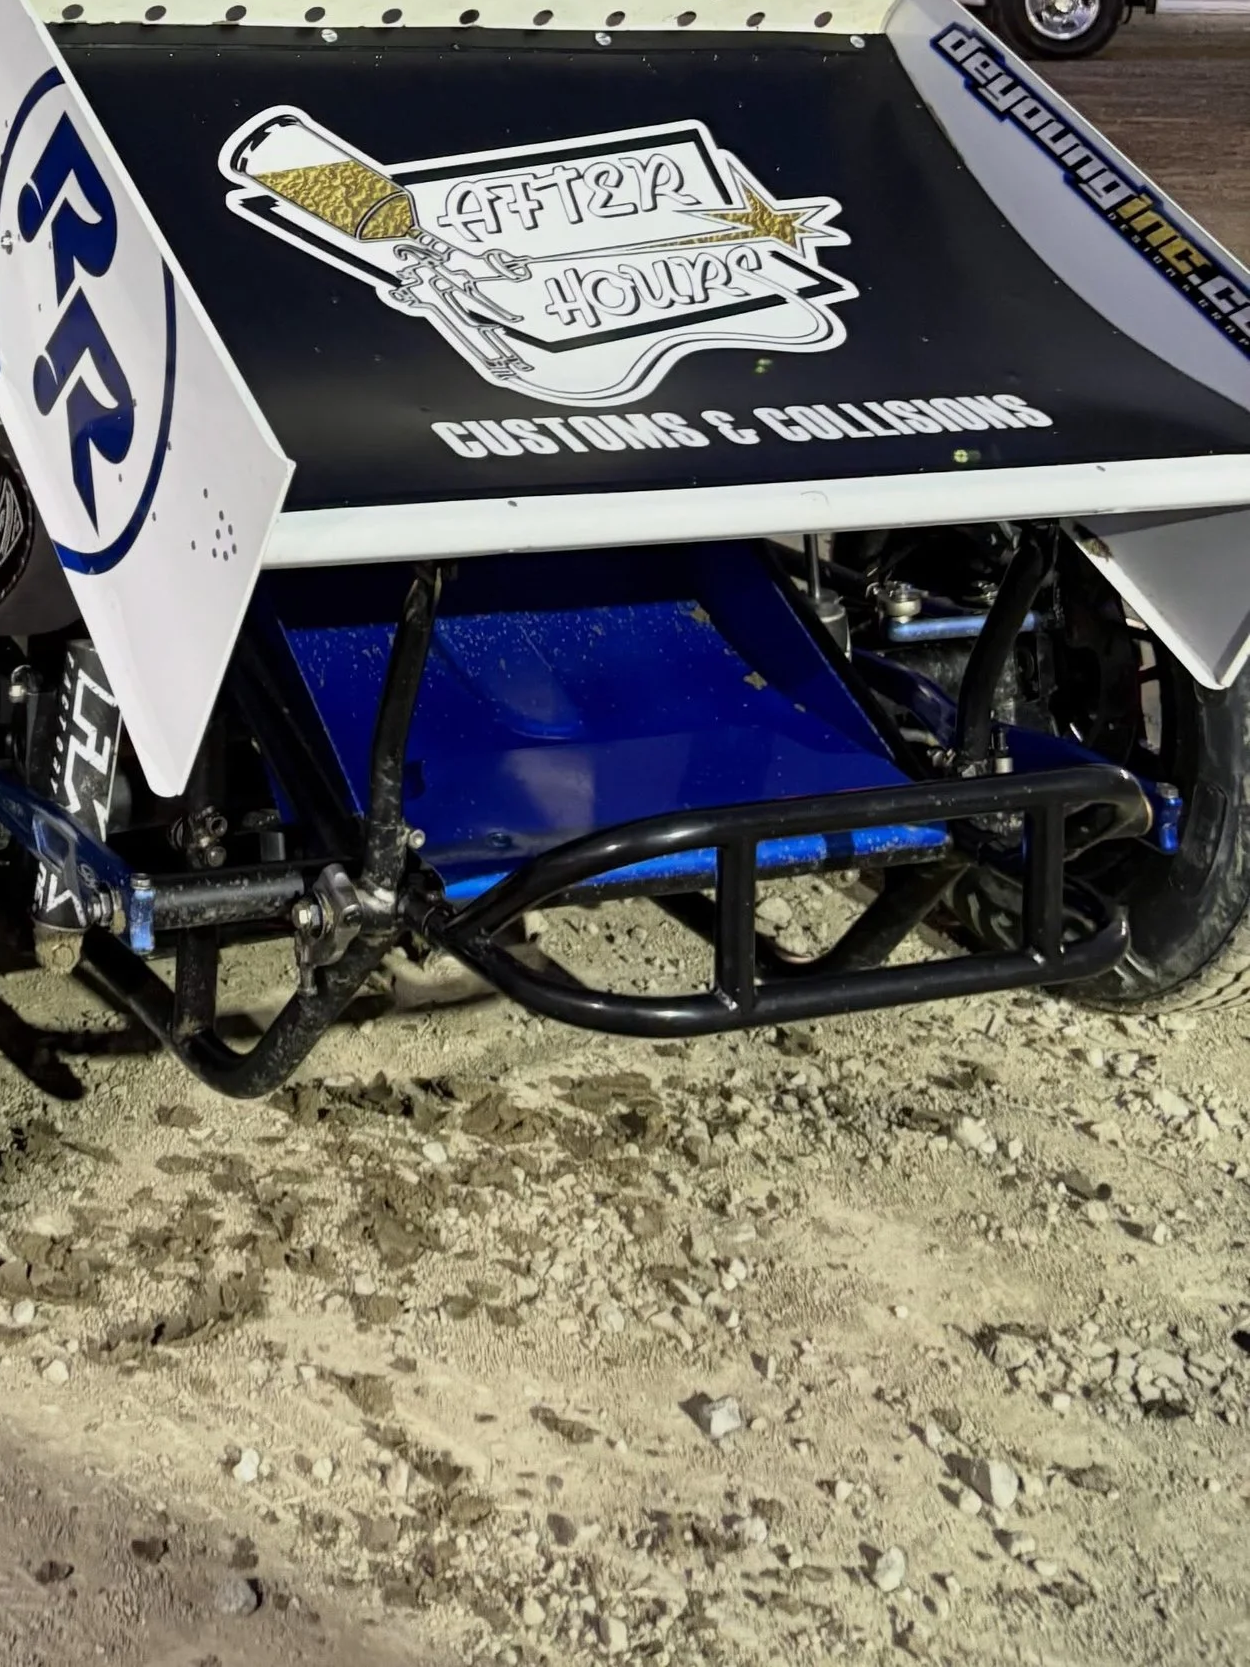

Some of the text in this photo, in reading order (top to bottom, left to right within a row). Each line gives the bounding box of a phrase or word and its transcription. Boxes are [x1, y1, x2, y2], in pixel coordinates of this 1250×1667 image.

[437, 153, 702, 242] AFTER
[545, 245, 762, 328] HOURS
[430, 394, 1054, 459] CUSTOMS & COLLISIONS
